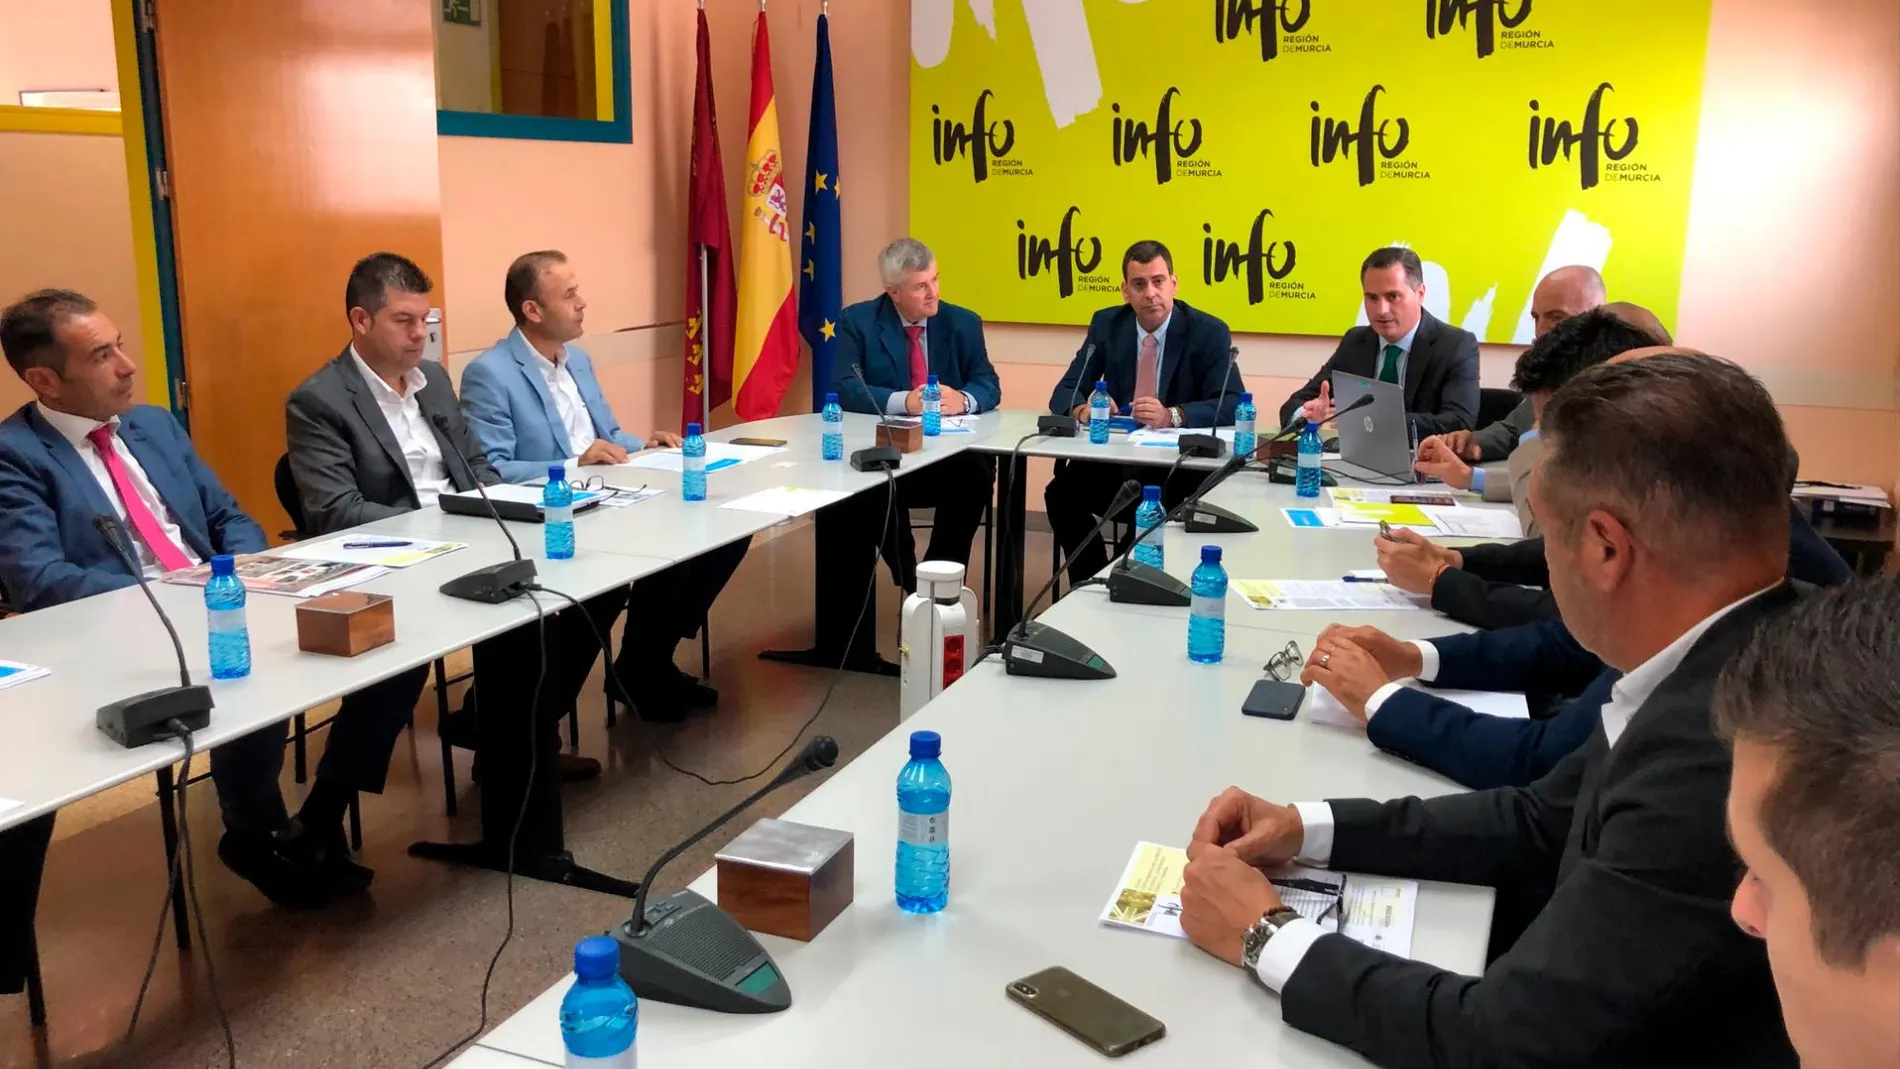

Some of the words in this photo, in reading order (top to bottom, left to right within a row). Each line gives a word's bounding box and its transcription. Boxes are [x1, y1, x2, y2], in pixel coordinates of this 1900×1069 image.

[1216, 0, 1310, 62] info
[1283, 34, 1319, 43] REGIÓN
[1426, 0, 1532, 59] info
[1501, 30, 1540, 39] REGIÓN
[932, 89, 1014, 183] info
[1112, 86, 1202, 185] info
[1177, 159, 1210, 167] REGIÓN
[1310, 84, 1409, 187] info
[1380, 160, 1418, 169] REGIÓN
[1529, 82, 1638, 190] info
[1606, 162, 1647, 171] REGIÓN
[1017, 206, 1101, 298] info
[1078, 275, 1110, 283] REGIÓN
[1203, 209, 1296, 305] info
[1269, 281, 1304, 289] REGIÓN
